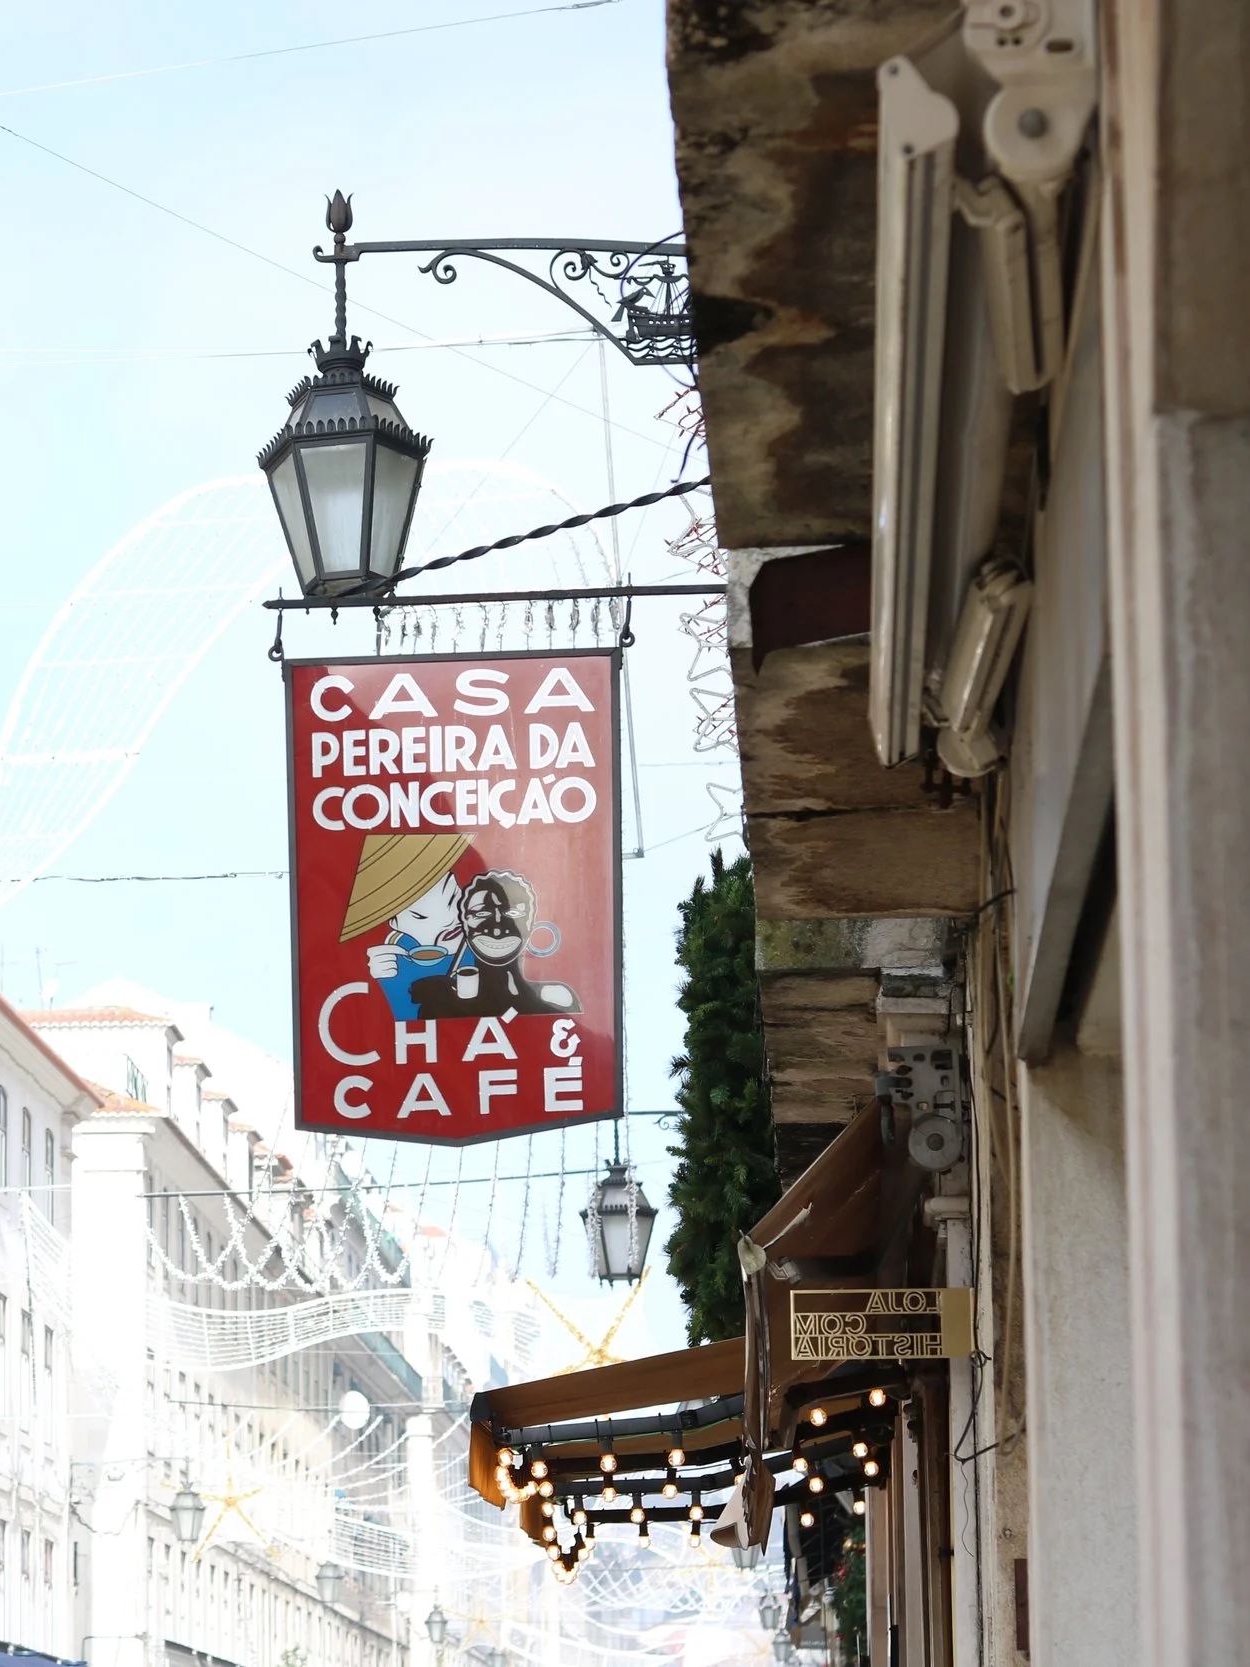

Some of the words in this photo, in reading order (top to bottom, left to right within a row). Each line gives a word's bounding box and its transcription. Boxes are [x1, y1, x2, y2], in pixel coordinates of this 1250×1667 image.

[310, 668, 595, 721] CASA
[312, 723, 515, 778] PEREIRA
[529, 721, 596, 769] DA
[318, 982, 519, 1067] CHÁ
[550, 1018, 582, 1058] &
[334, 1057, 584, 1120] CAFÉ
